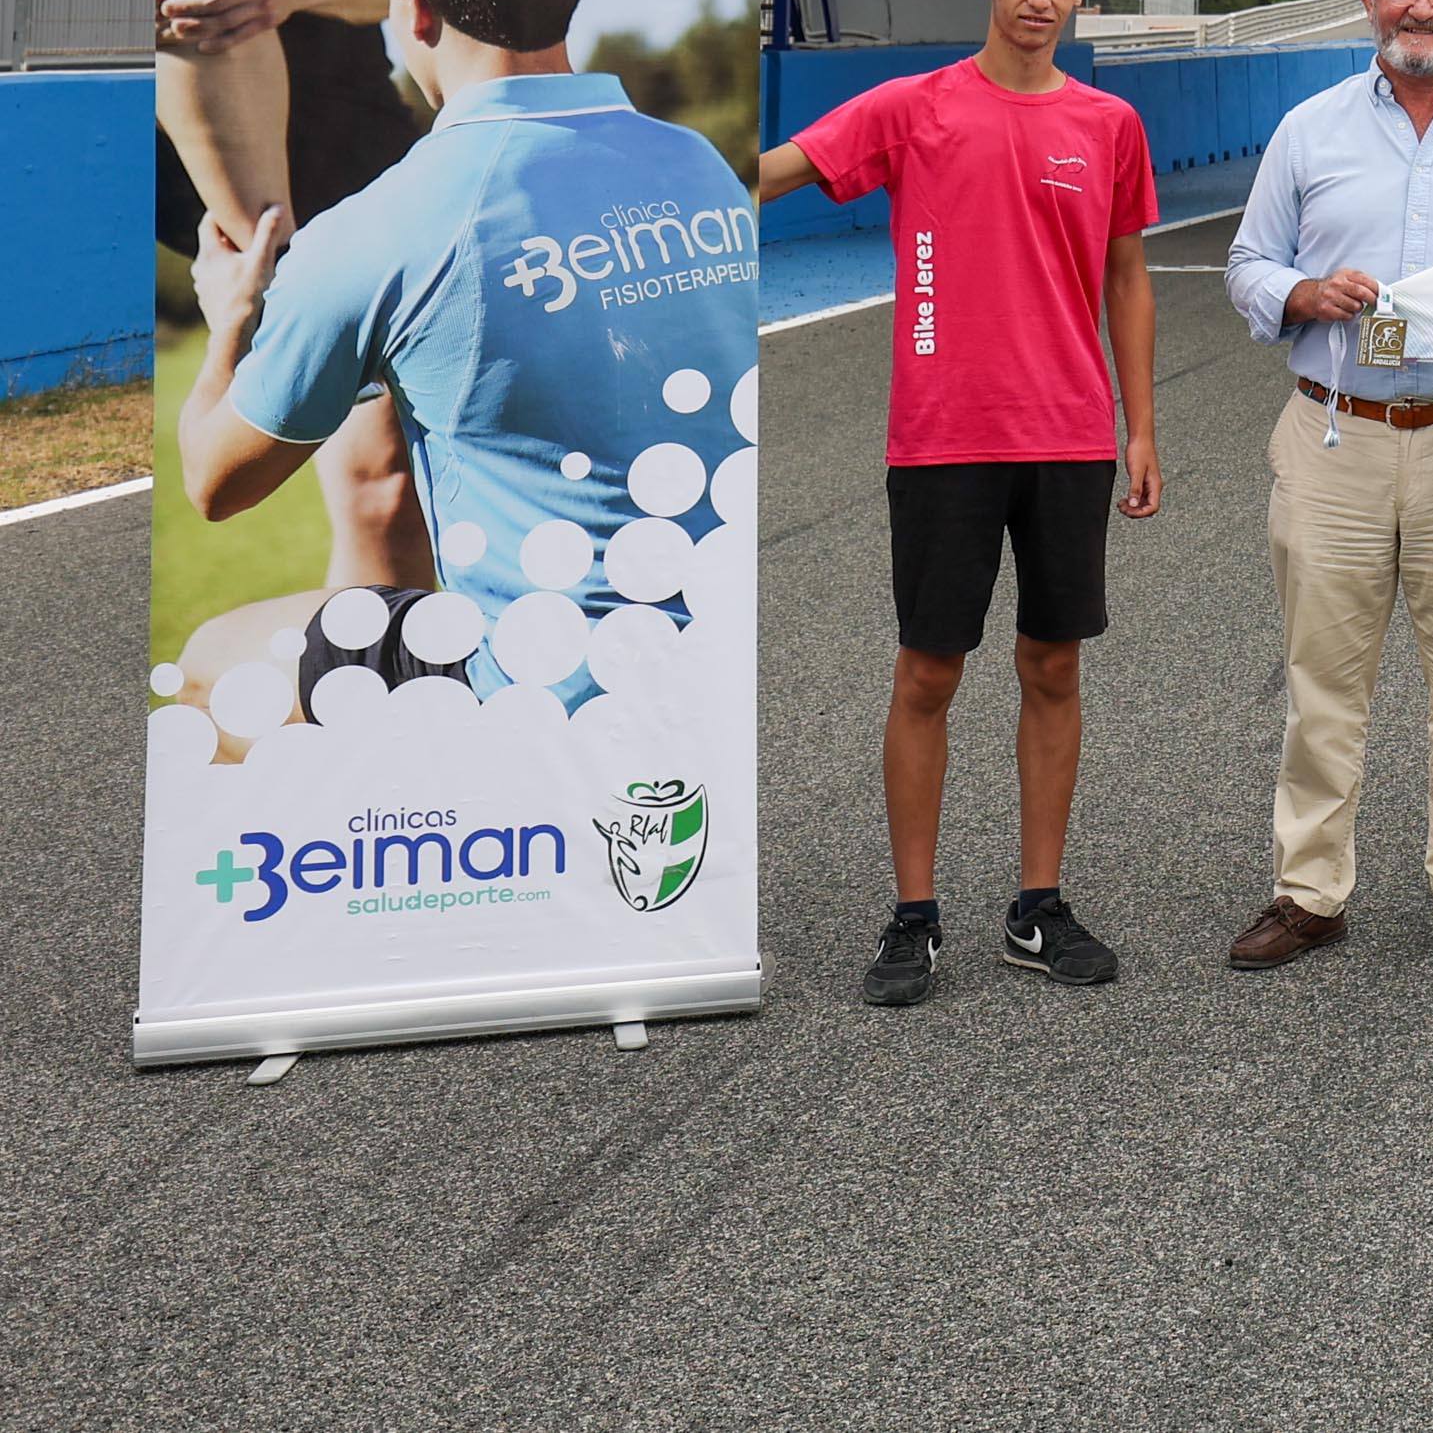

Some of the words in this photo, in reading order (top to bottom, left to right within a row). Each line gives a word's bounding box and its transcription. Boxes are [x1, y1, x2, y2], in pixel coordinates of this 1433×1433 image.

[601, 200, 681, 230] clínica
[520, 206, 758, 313] Beiman
[914, 230, 935, 297] Jerez
[913, 301, 935, 356] Bike
[347, 806, 457, 834] clínicas
[239, 822, 567, 923] Beiman
